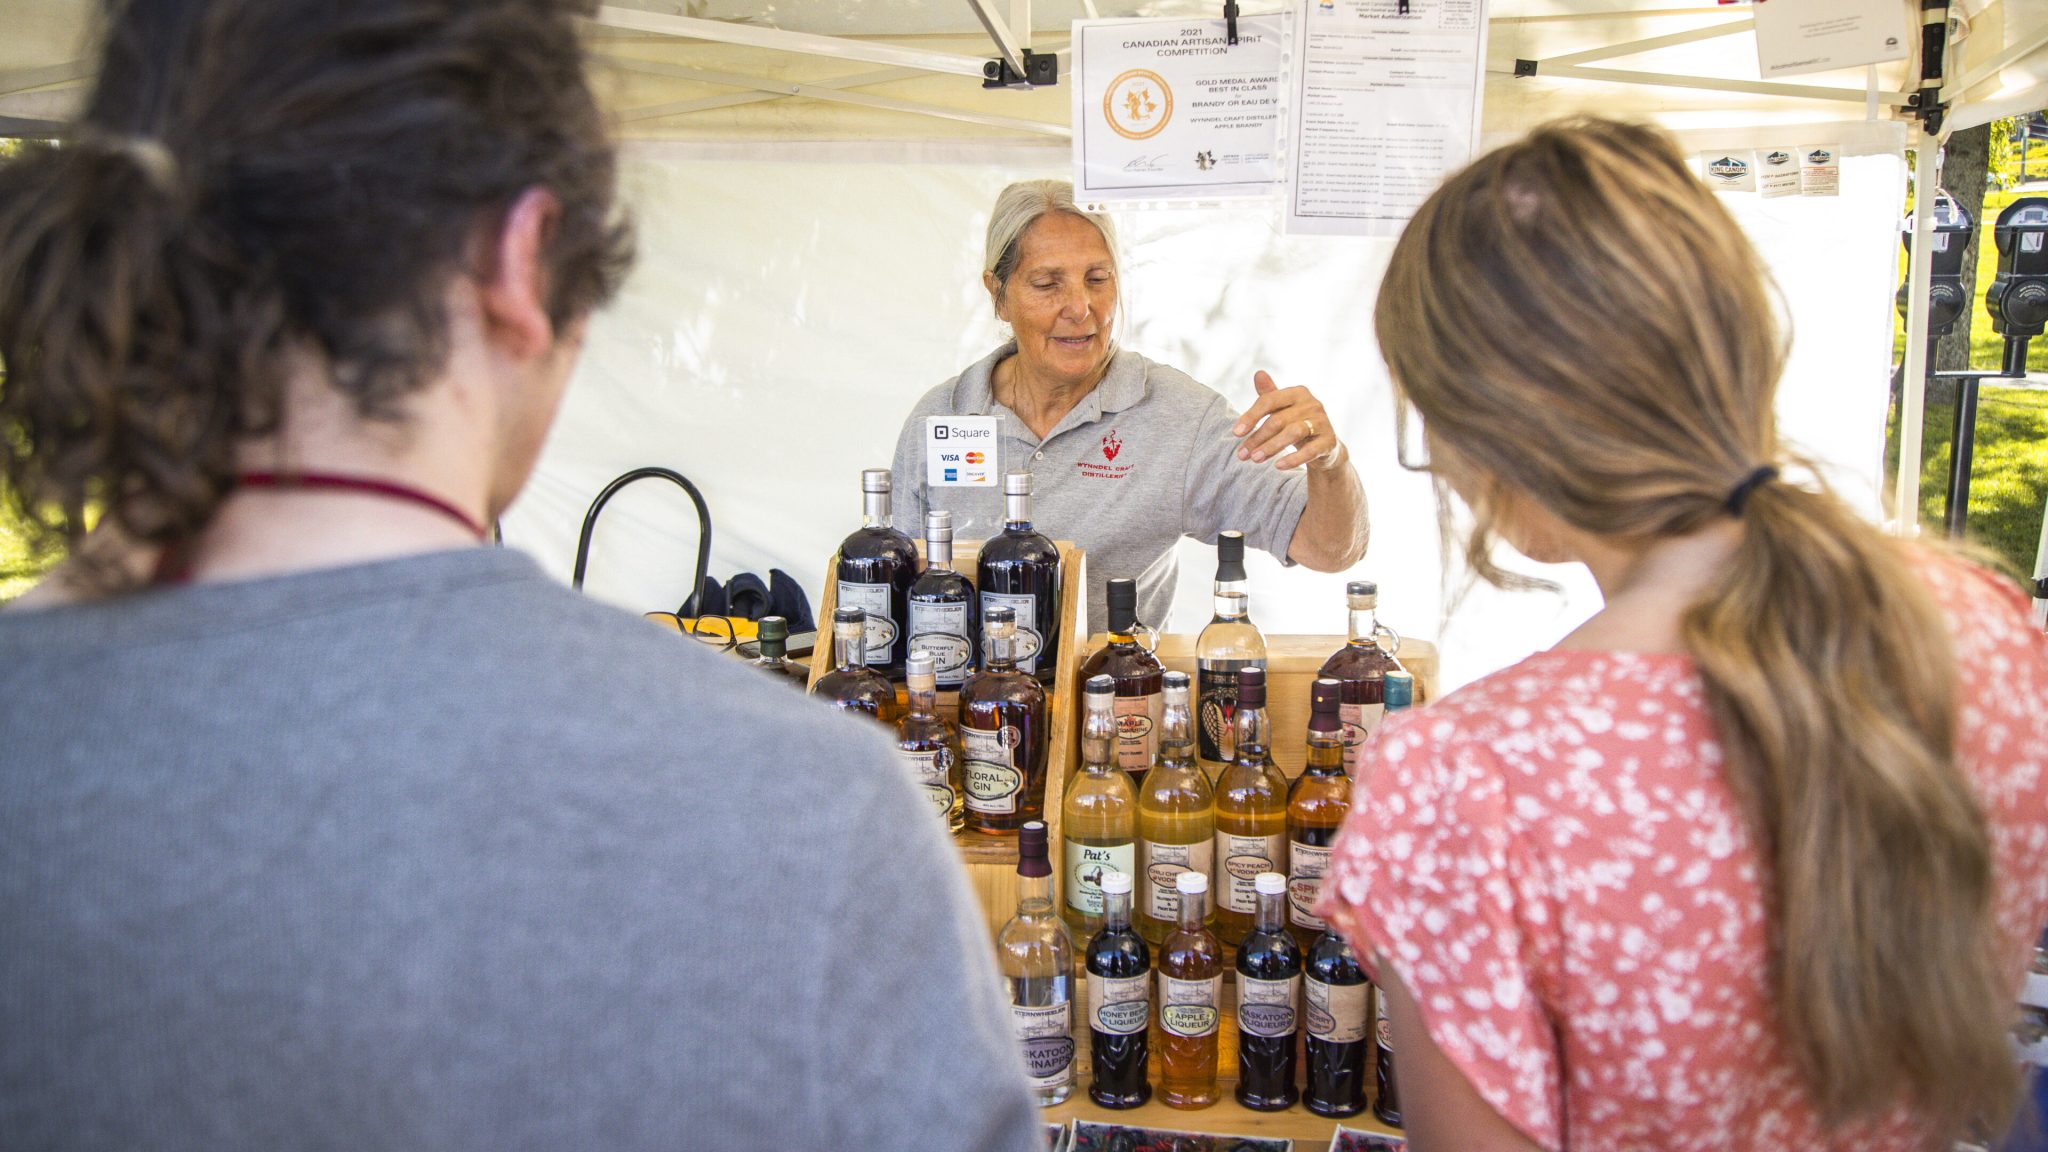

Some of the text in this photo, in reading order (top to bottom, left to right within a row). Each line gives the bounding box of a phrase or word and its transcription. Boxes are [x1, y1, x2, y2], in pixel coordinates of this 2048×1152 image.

[1180, 28, 1203, 36] 2021
[1122, 35, 1262, 49] CANADIAN ARTISAN PIRIT
[1157, 47, 1228, 57] COMPETITION
[951, 427, 990, 440] Square
[941, 454, 960, 462] VISA
[1077, 462, 1113, 471] WYNNDEL
[936, 657, 946, 665] IN
[965, 768, 1004, 782] FLORAL
[973, 781, 991, 792] GIN
[1083, 848, 1111, 861] Pat's
[1228, 861, 1246, 869] SPICY
[1150, 868, 1165, 876] CHILI
[1297, 882, 1319, 894] SPIC
[1014, 1006, 1066, 1017] STERNWHEELER
[1100, 1010, 1129, 1019] HONEY
[1175, 1012, 1206, 1021] APPLE
[1109, 1015, 1144, 1026] LIQUEUR
[1170, 1018, 1210, 1029] LIQUEUR
[1245, 1018, 1286, 1029] LIQUEUR
[1022, 1044, 1072, 1059] SKATOON
[1026, 1054, 1073, 1069] HNAPPS
